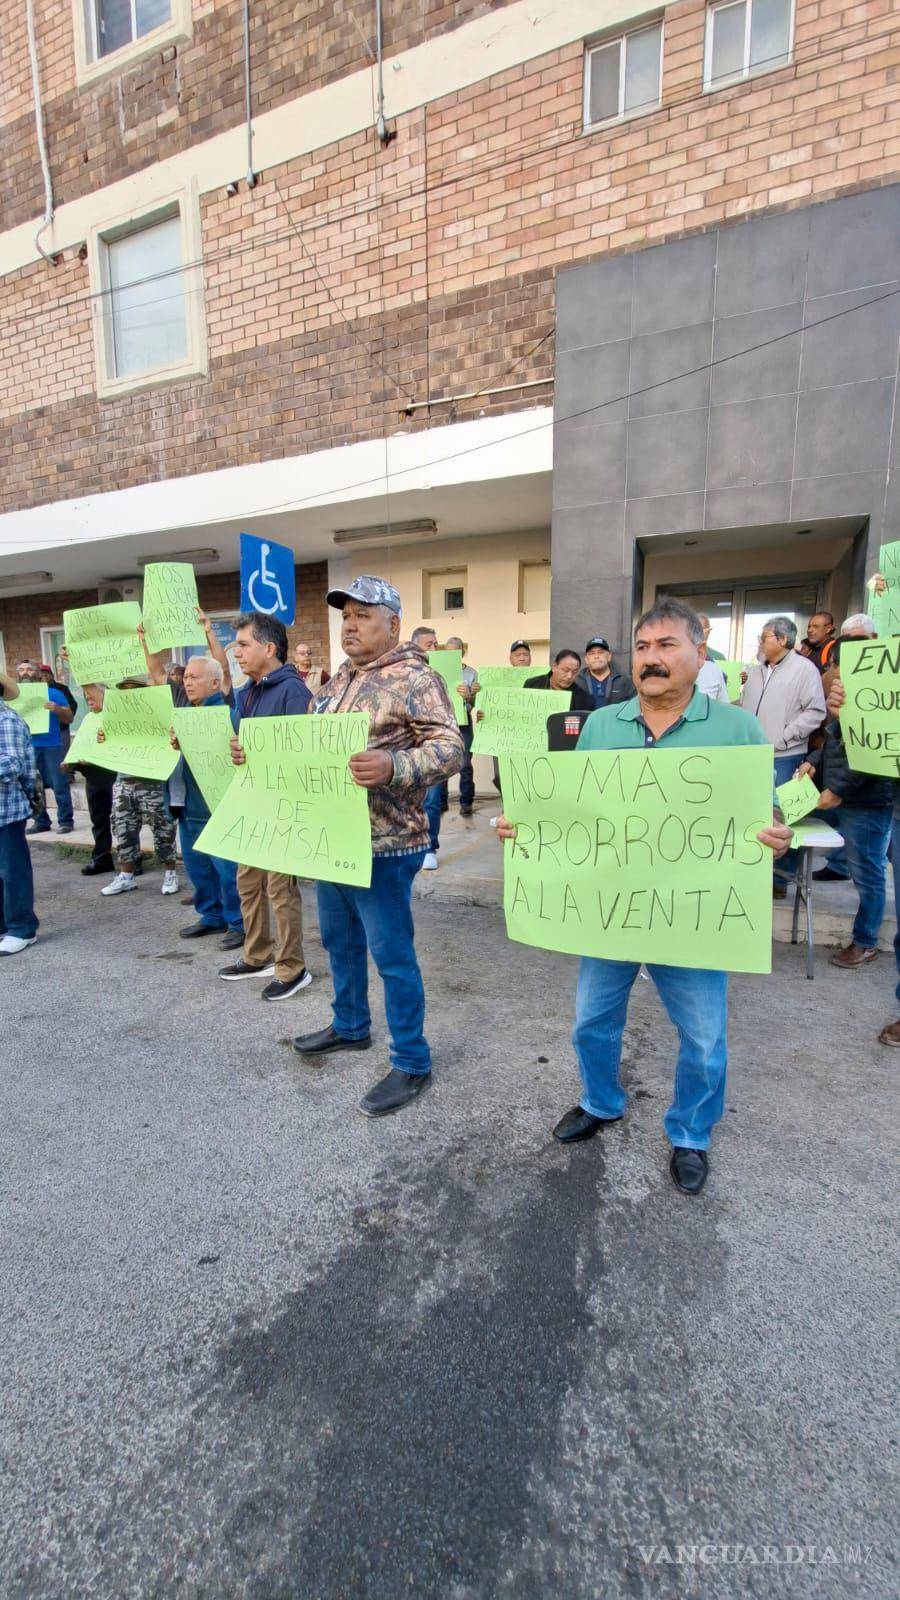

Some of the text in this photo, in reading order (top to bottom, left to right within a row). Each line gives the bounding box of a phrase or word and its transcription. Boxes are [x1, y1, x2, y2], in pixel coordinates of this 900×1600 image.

[242, 718, 368, 756] NO MAS FRENOS
[241, 763, 358, 796] A LA VENTA
[509, 754, 713, 804] NO MAS
[276, 798, 315, 823] DE
[598, 885, 755, 931] VENTA
